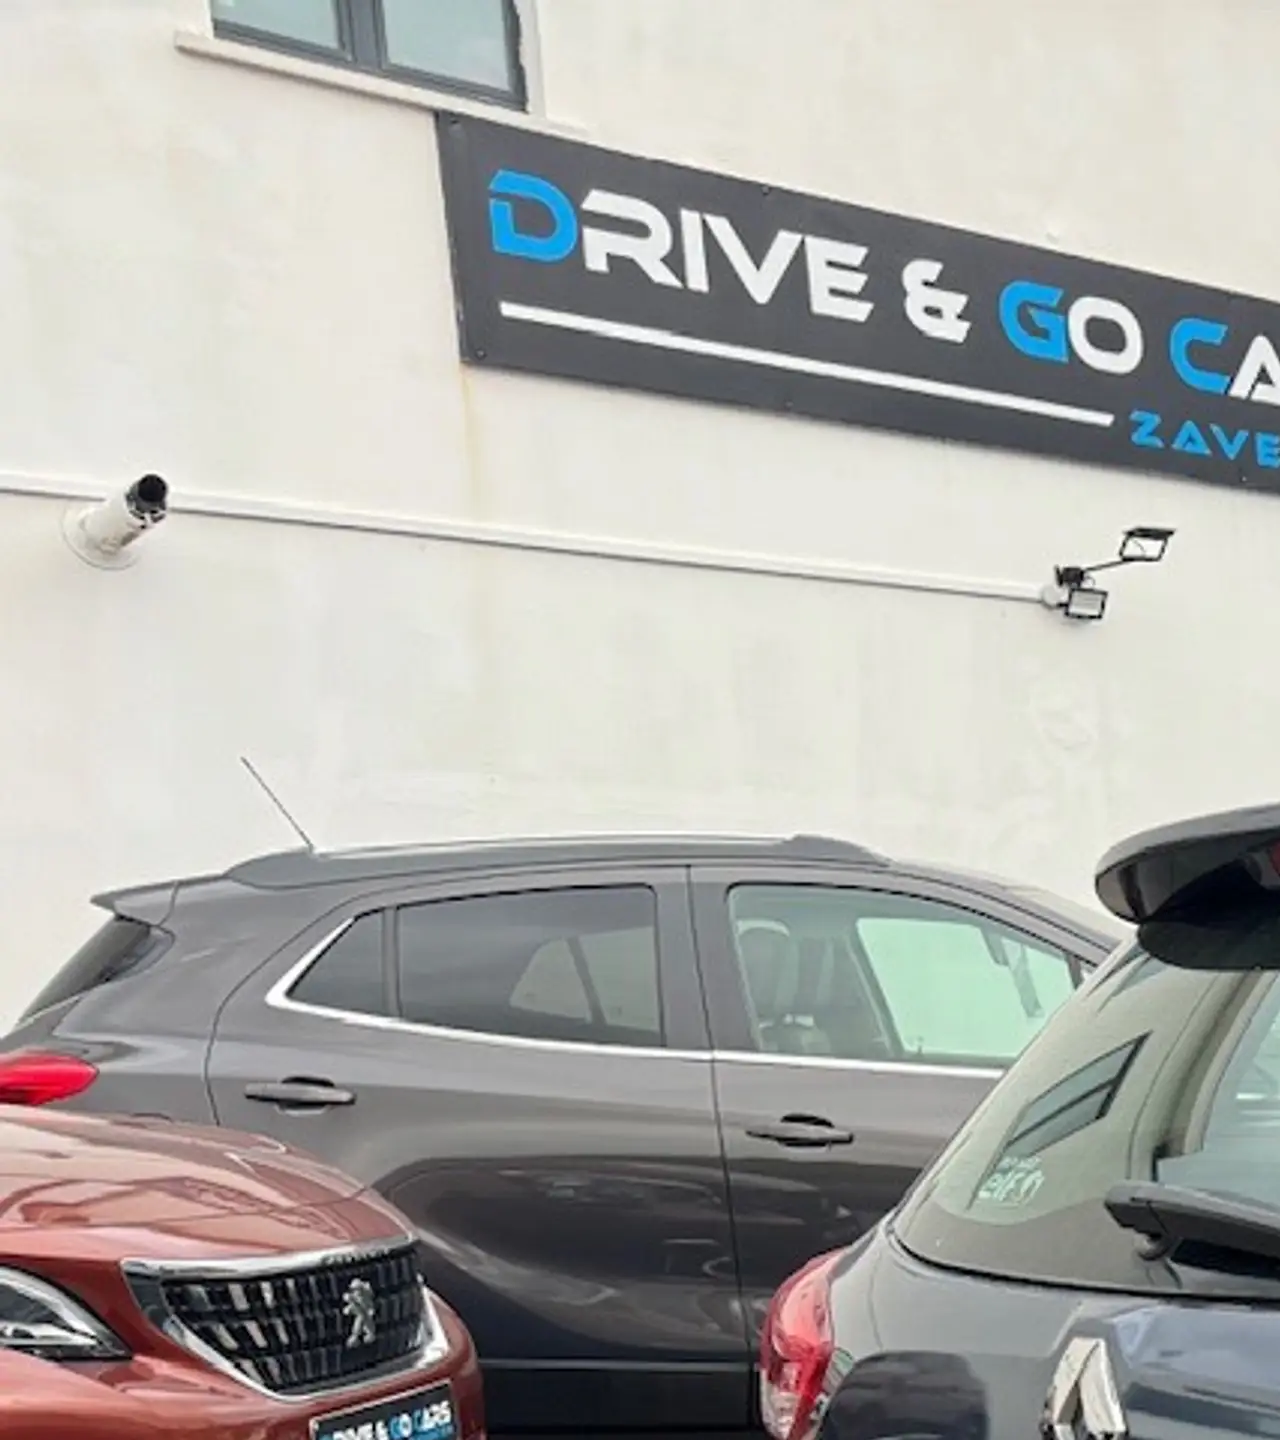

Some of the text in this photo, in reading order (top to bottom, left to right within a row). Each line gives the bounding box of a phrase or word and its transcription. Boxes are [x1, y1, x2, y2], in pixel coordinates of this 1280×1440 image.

[487, 167, 875, 323] DRIVE
[901, 258, 972, 344] &
[998, 278, 1144, 375] GO
